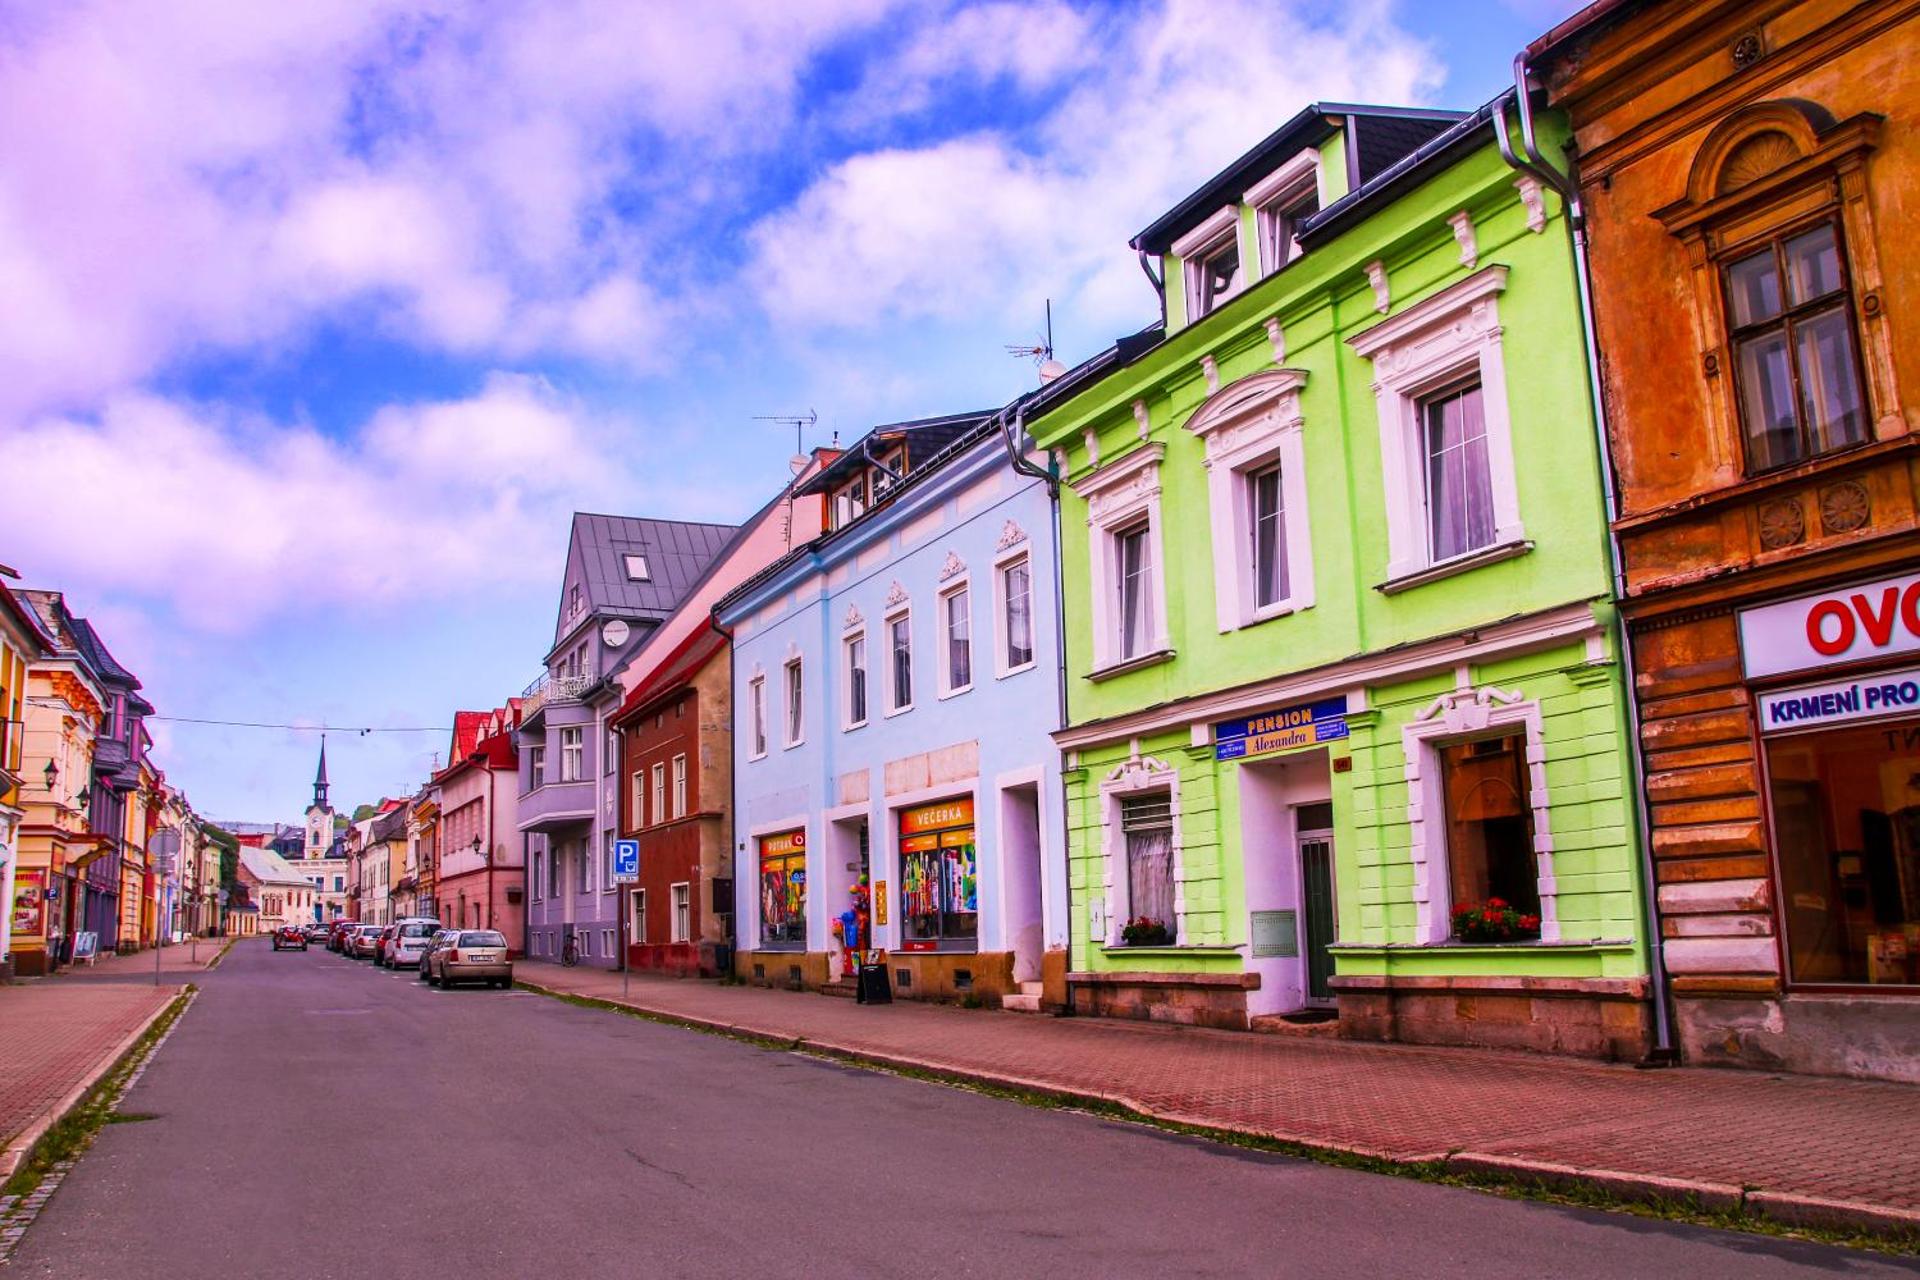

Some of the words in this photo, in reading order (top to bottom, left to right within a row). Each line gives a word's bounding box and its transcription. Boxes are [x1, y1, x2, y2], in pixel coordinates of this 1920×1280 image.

[1770, 684, 1859, 723] KRMENÍ
[1866, 681, 1919, 709] PRO
[1247, 708, 1313, 735] PENSION
[1252, 730, 1306, 753] Alexandra
[917, 805, 962, 826] VEČERKA
[619, 844, 634, 864] P
